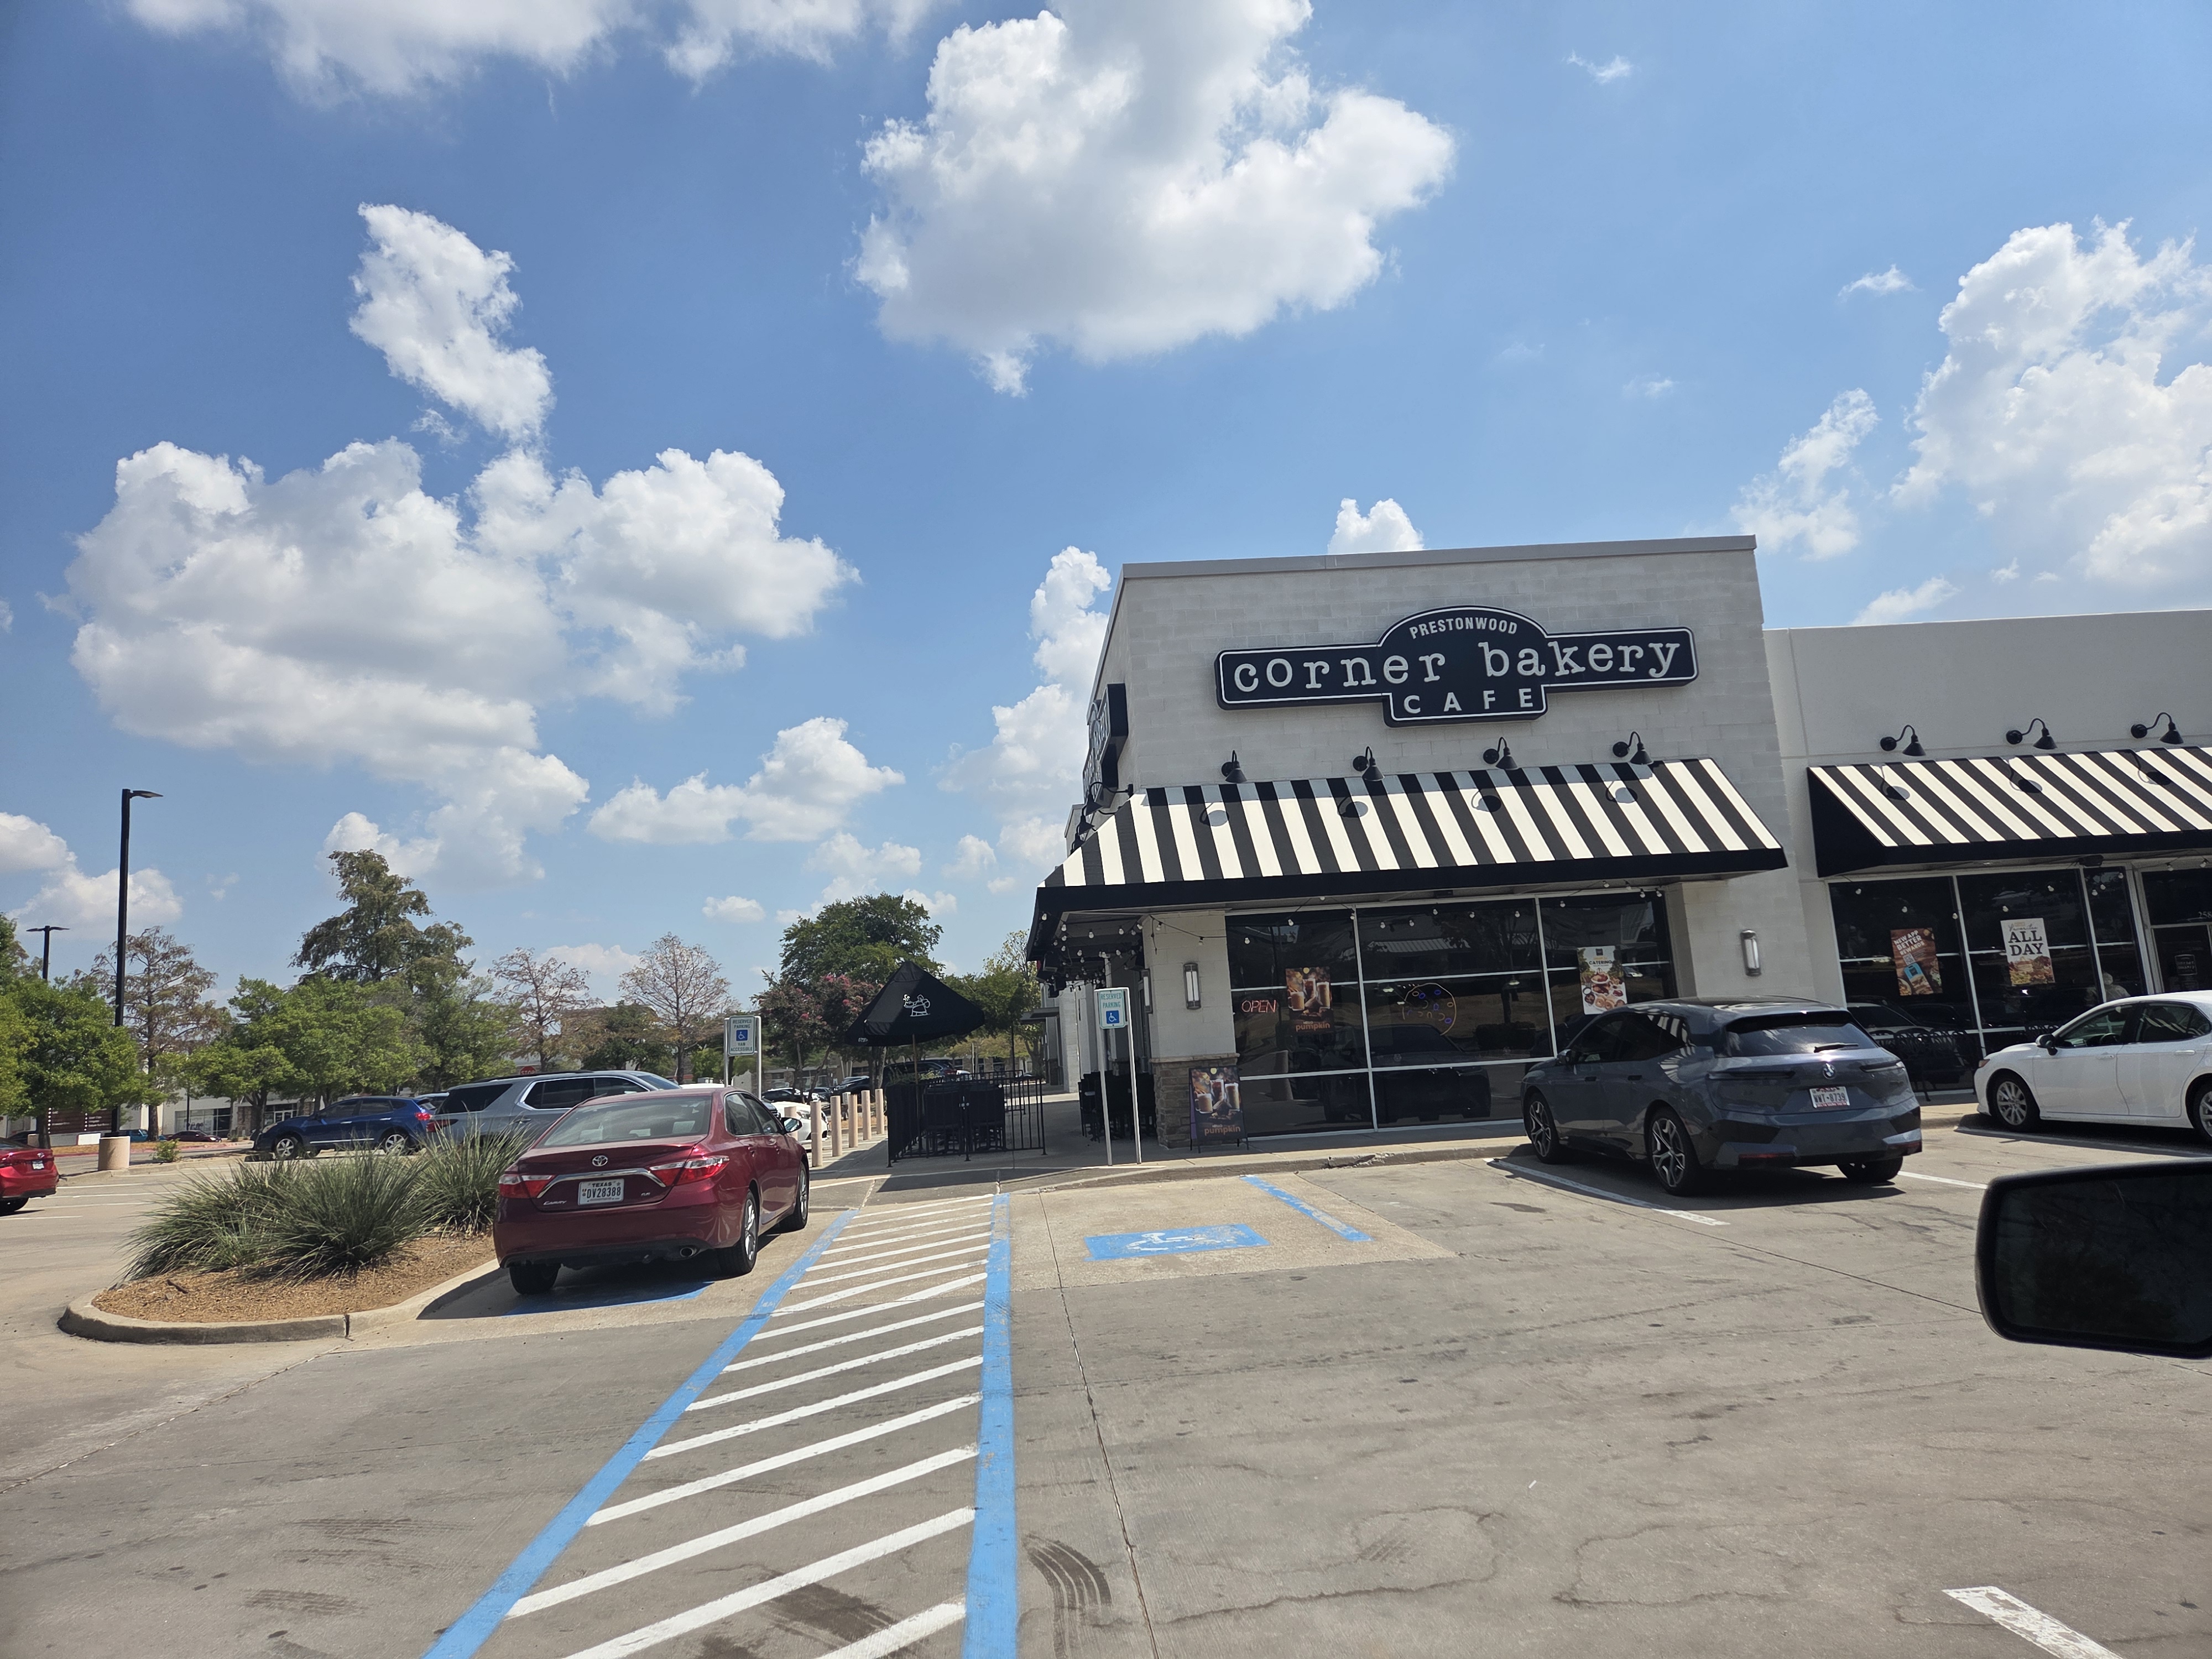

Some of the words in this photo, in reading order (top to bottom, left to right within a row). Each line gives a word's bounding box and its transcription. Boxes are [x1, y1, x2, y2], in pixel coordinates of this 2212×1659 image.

[1409, 617, 1517, 639] PRESTONWOOD
[1234, 653, 1446, 692] corner
[1478, 640, 1681, 678] bakery
[1403, 688, 1533, 714] CAFE
[1893, 935, 1907, 945] NEW
[1907, 930, 1918, 938] APP
[1896, 935, 1922, 951] BETTER
[2008, 930, 2043, 943] ALL
[1900, 941, 1925, 955] REWARDS
[2009, 943, 2044, 956] DAY
[1241, 999, 1276, 1013] OPEN
[1296, 1022, 1331, 1032] pumpkin
[1204, 1125, 1241, 1136] pumpkin
[587, 1187, 621, 1198] DV28388
